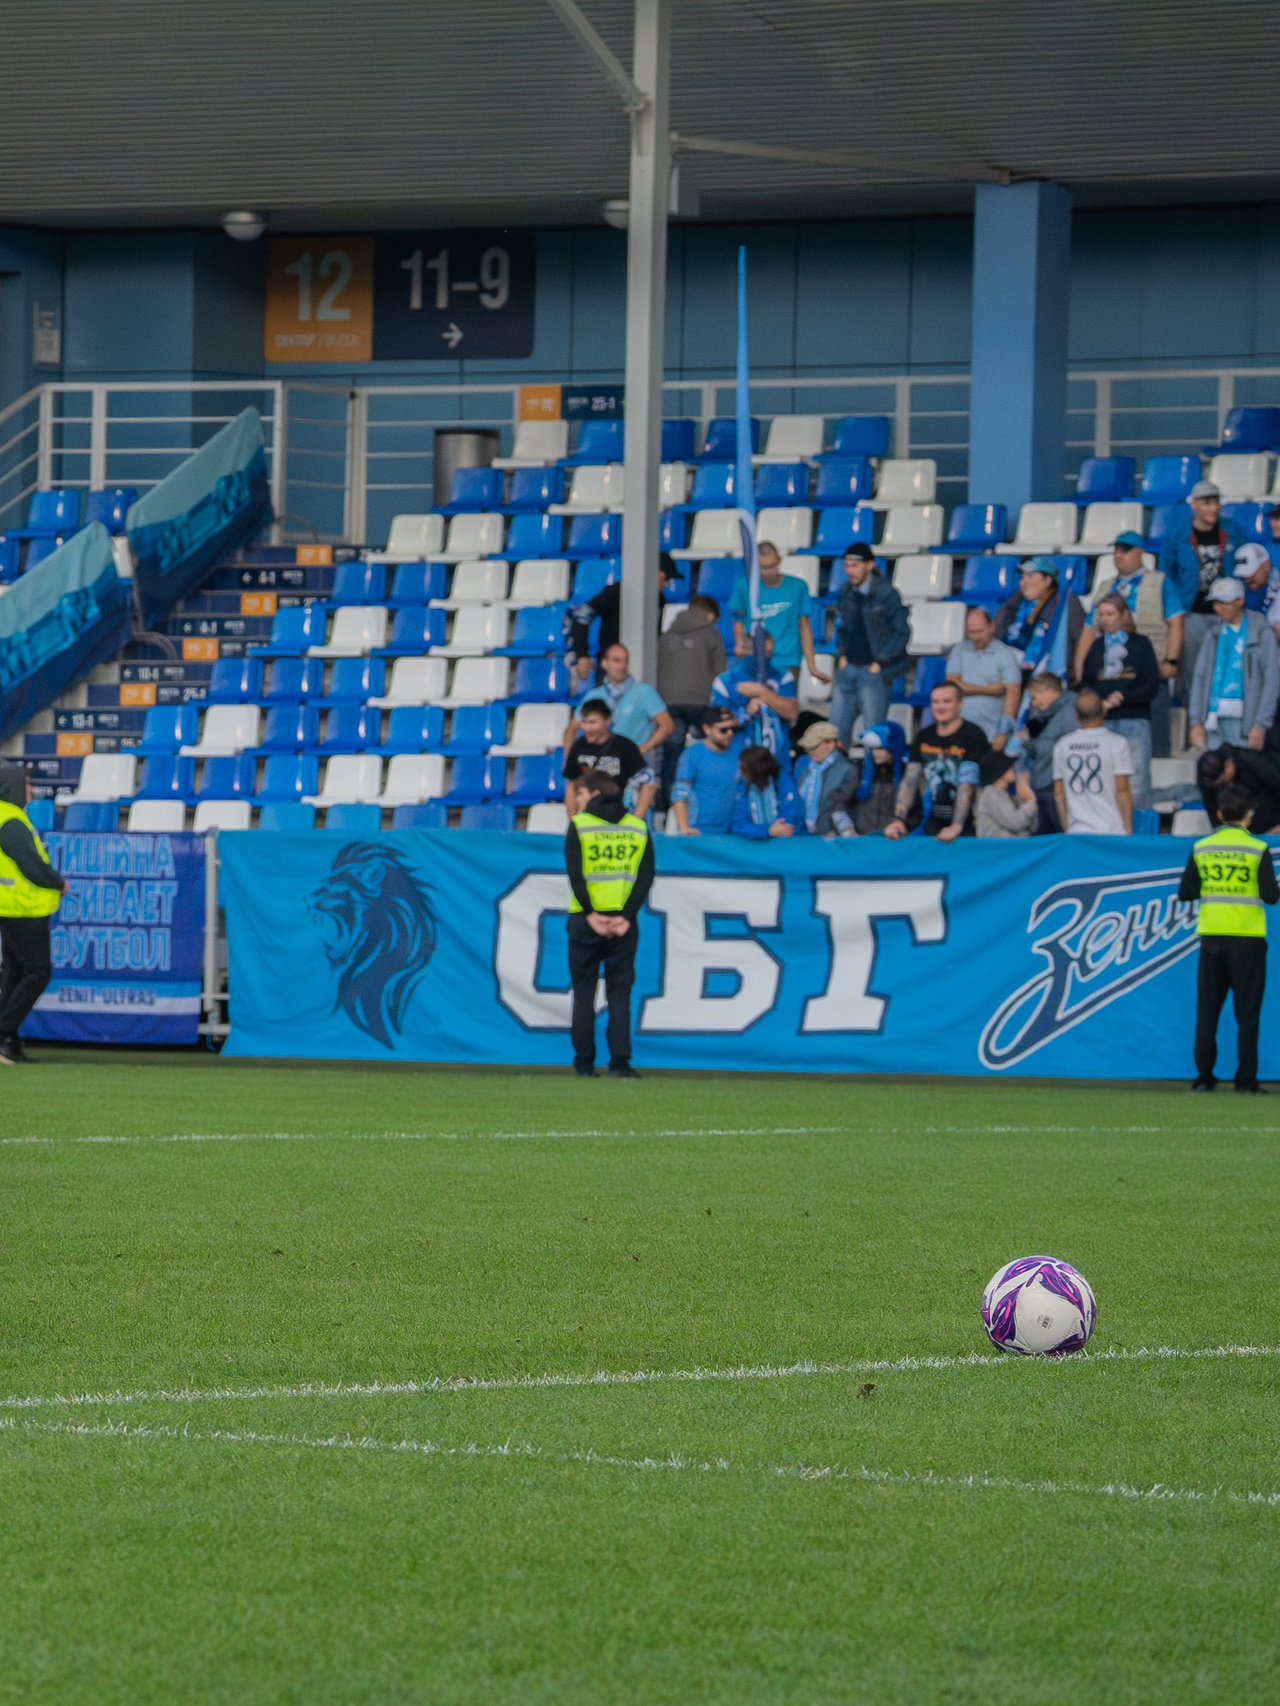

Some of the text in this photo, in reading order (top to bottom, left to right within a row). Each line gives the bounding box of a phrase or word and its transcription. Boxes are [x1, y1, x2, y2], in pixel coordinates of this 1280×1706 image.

[285, 250, 352, 321] 12
[1067, 753, 1103, 795] 88
[44, 832, 175, 878] ТИШИНА
[589, 844, 639, 861] 3487
[60, 879, 179, 924] БИВАЕТ
[50, 925, 172, 972] ФУТБОЛ
[494, 870, 948, 1036] СБГ
